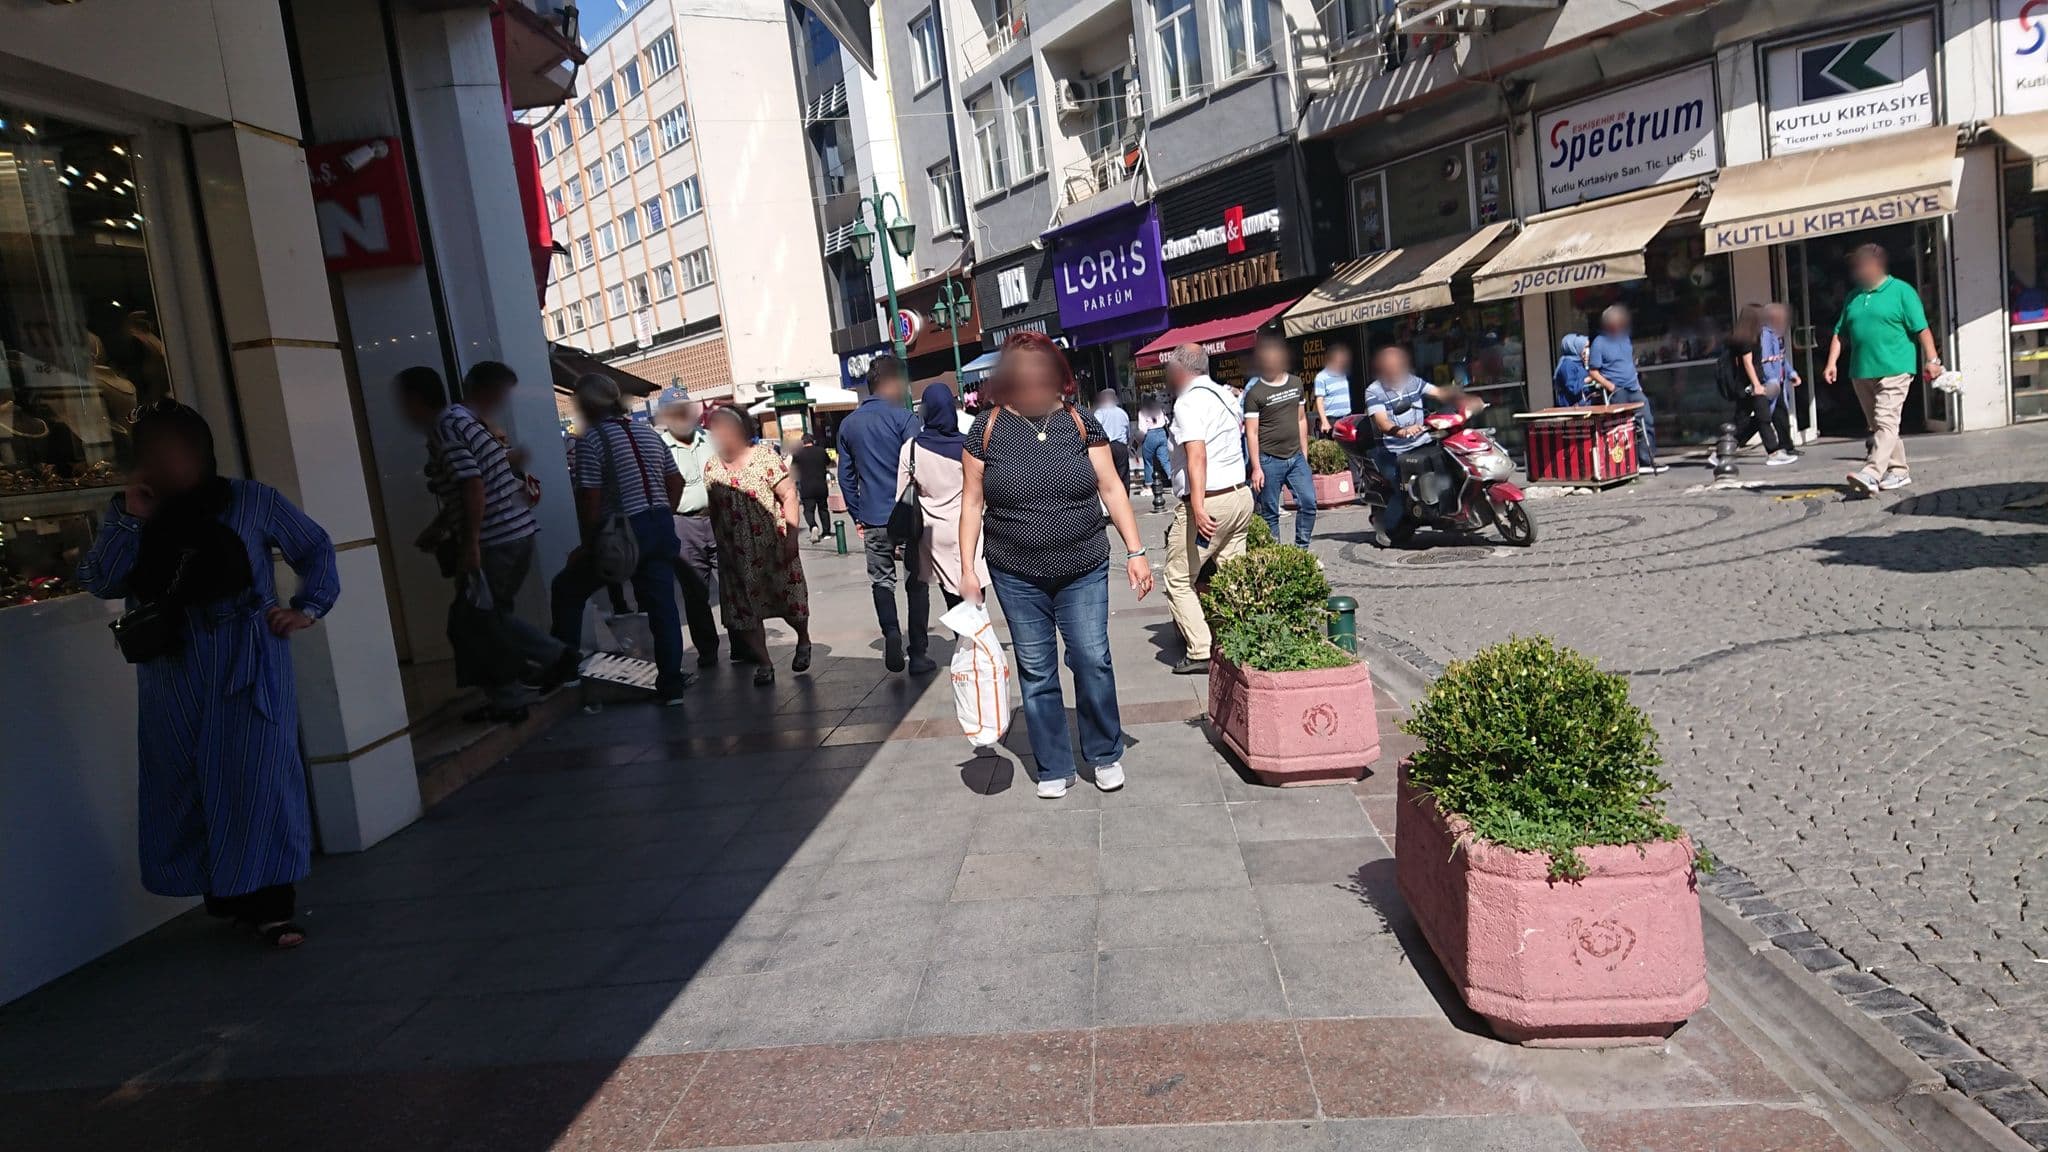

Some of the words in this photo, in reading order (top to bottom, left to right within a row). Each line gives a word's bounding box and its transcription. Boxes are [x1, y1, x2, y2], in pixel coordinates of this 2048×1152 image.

[1775, 111, 1831, 133] KUTLU
[1838, 91, 1930, 121] KIRTASİYE
[1550, 99, 1703, 173] Spectrum
[1784, 134, 1819, 146] Ticaret
[1551, 180, 1576, 195] Kutlu
[1646, 159, 1664, 171] Tic.
[1667, 152, 1687, 166] Ltd.
[1227, 220, 1239, 240] &
[1717, 219, 1795, 248] KUTLU
[1804, 194, 1941, 233] KIRTASİYE
[1063, 240, 1146, 295] LORIS
[1312, 311, 1347, 329] KUTLU
[1351, 296, 1411, 320] KIRTASİYE
